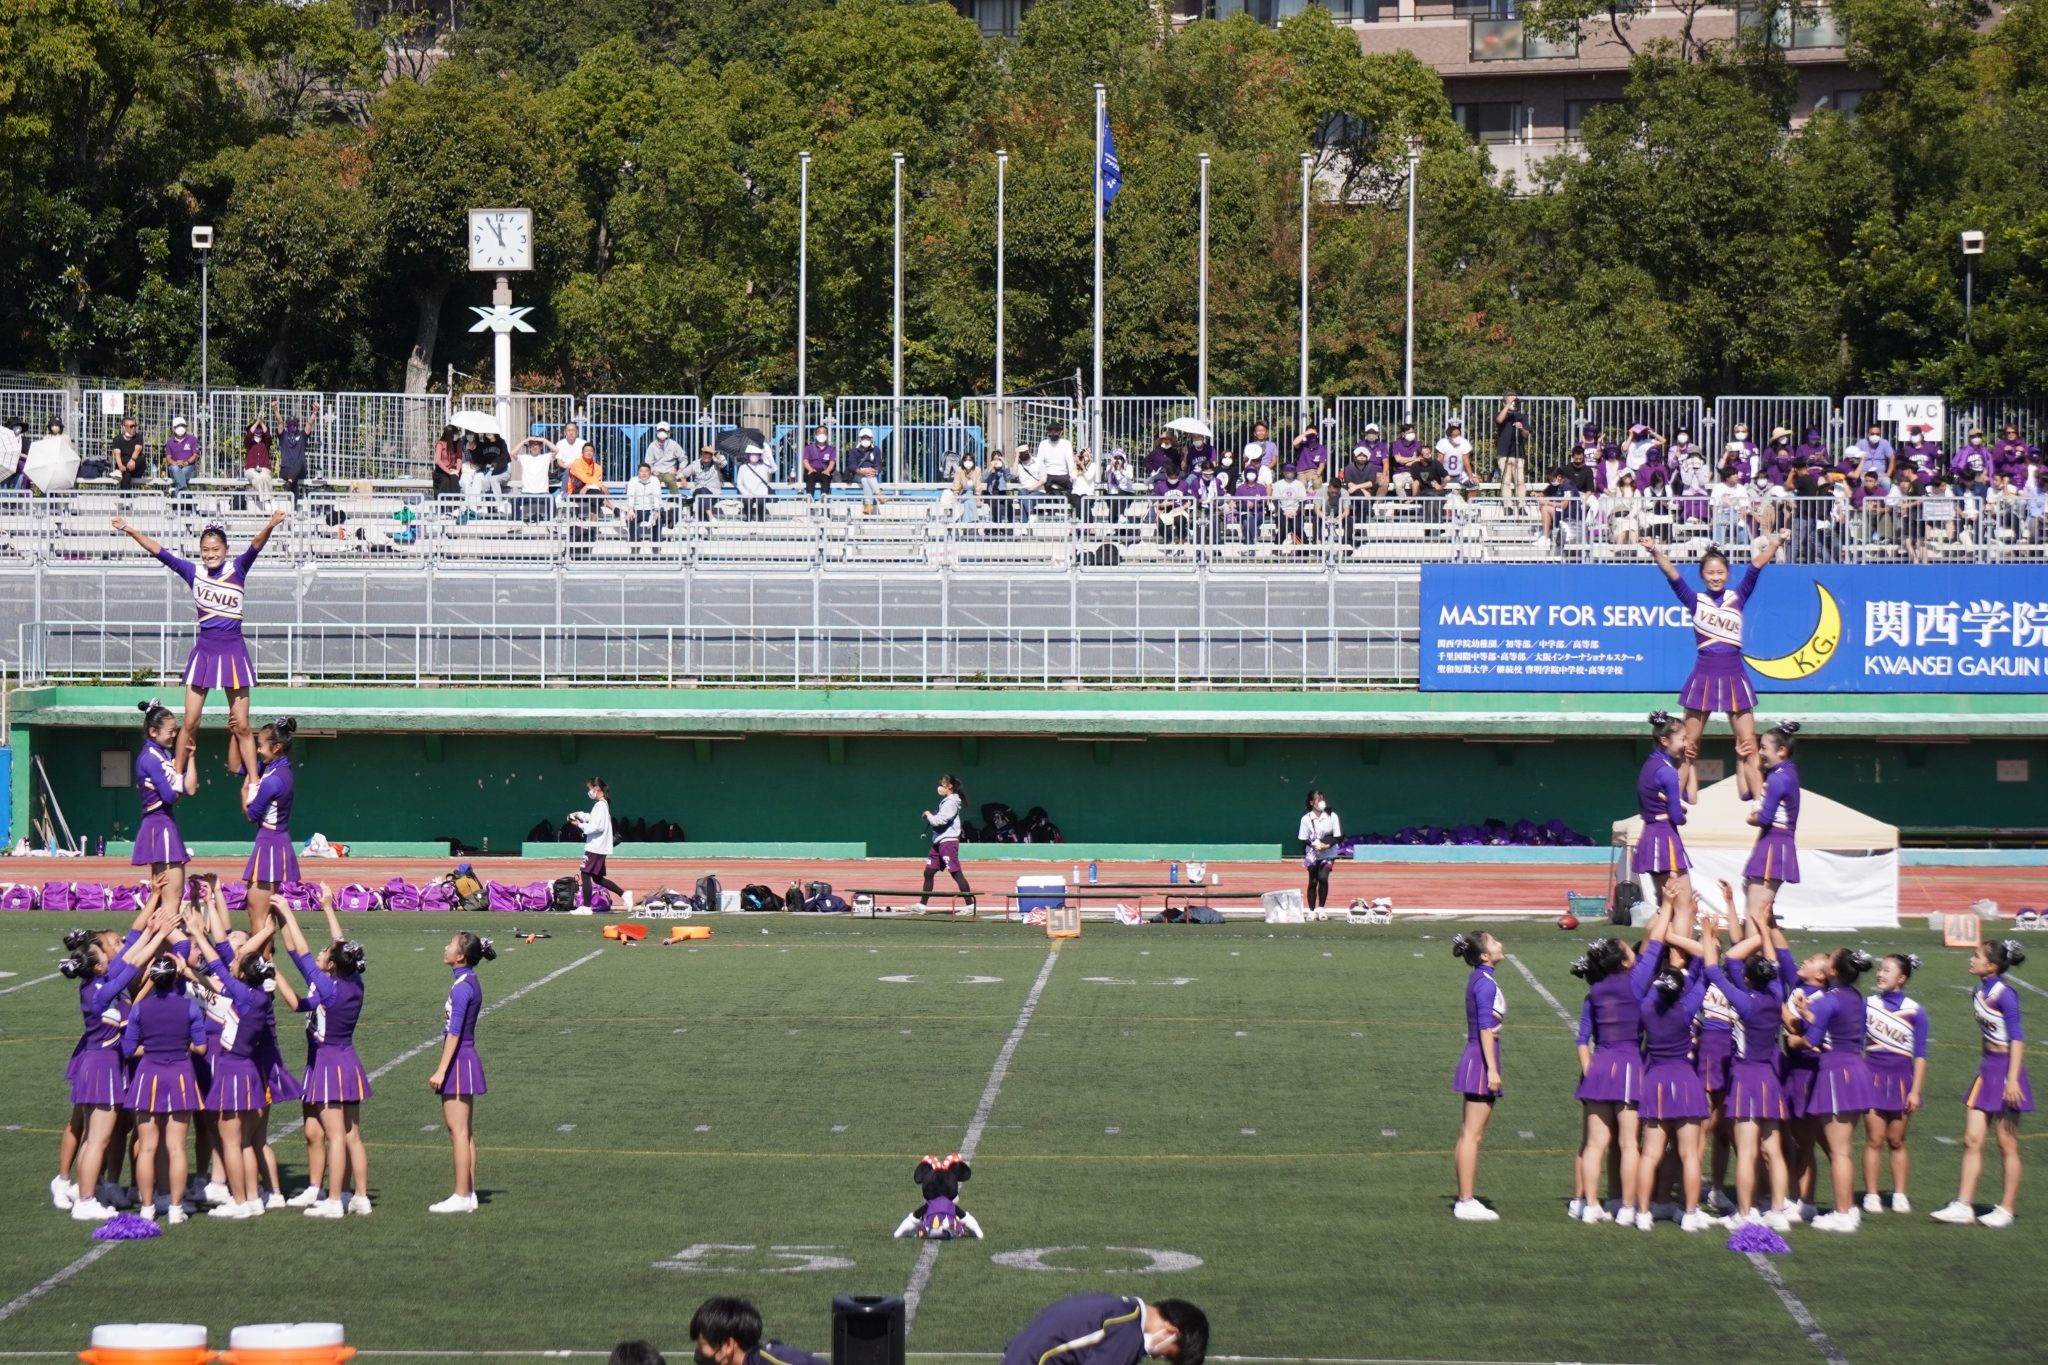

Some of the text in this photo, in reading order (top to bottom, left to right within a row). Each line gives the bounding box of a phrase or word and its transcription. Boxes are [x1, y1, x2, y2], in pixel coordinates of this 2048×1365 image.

[495, 213, 504, 222] 12
[474, 234, 481, 244] 9
[520, 234, 527, 244] 3
[497, 256, 505, 266] 6
[1448, 455, 1459, 471] 8
[197, 586, 239, 608] VENUS
[1438, 604, 1694, 627] MASTERY FOR SERVICE
[1700, 610, 1740, 635] VENUS
[1864, 655, 1954, 677] KWANSEI
[1957, 655, 2042, 678] GAKUIN
[1050, 908, 1078, 931] 50
[1948, 915, 1976, 942] 40
